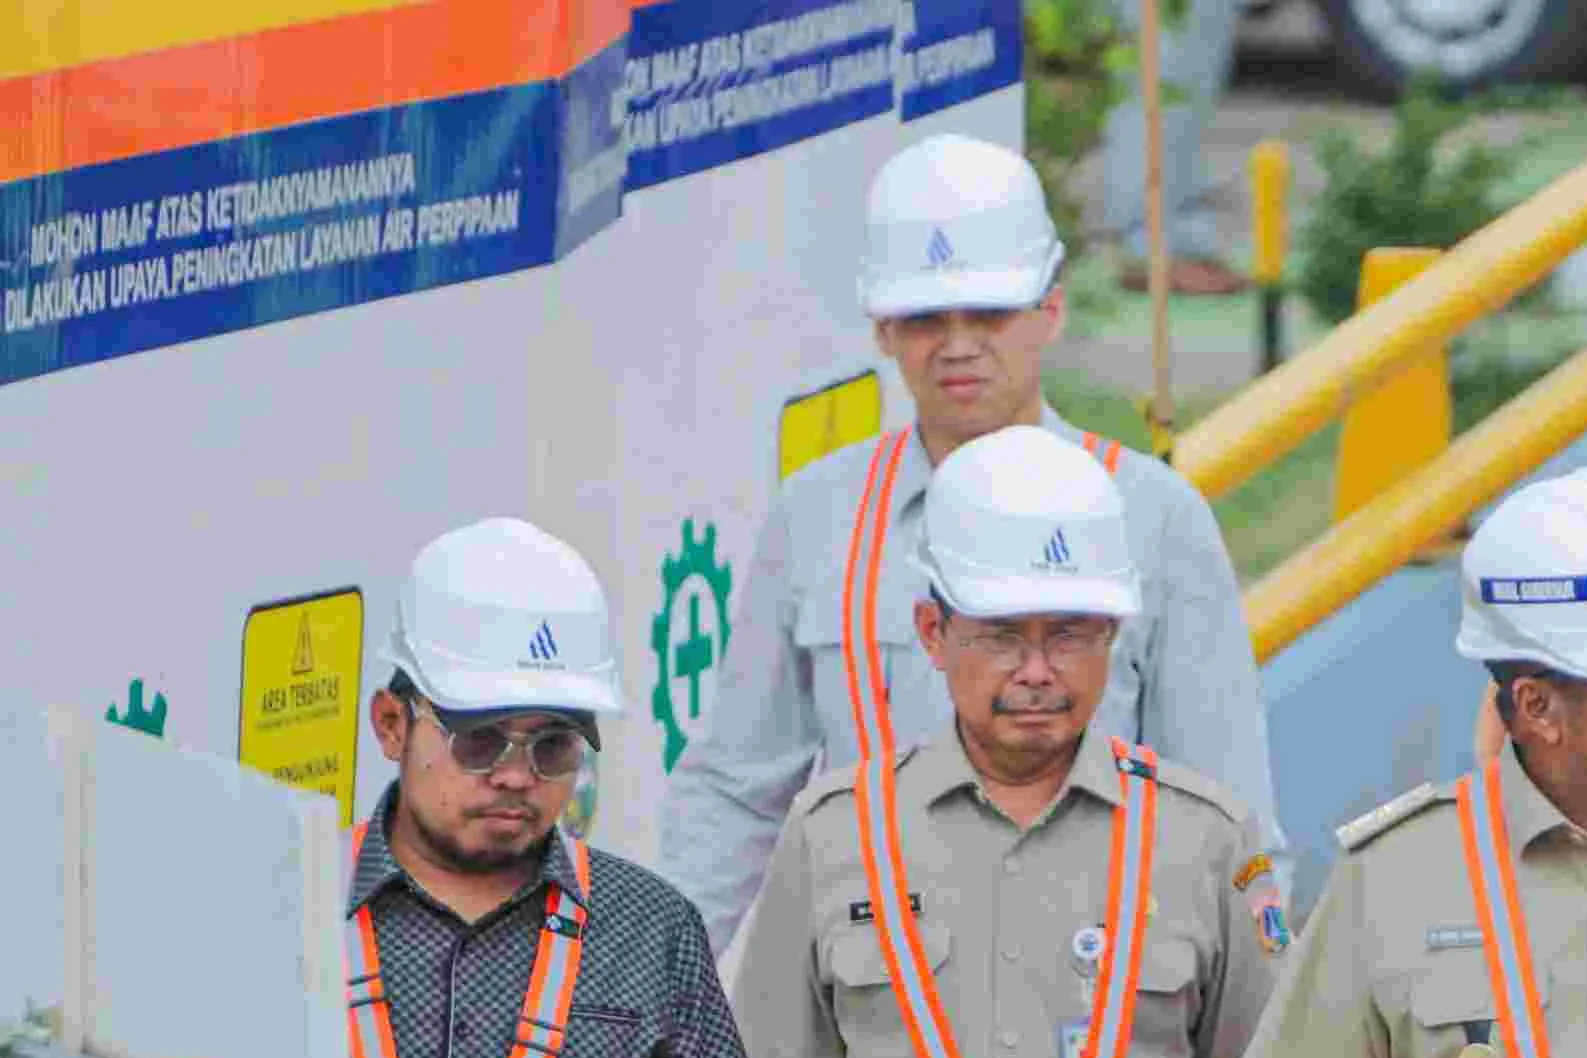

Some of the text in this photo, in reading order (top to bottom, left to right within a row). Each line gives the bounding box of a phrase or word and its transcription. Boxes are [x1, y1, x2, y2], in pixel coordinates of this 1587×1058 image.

[4, 189, 519, 333] DILAKUKAN UPAYA PENINGKATAN LAYANAN AIR PERPIPAAN
[30, 209, 97, 266] MOHON
[100, 201, 151, 251] MAAF
[154, 190, 203, 240] ATAS
